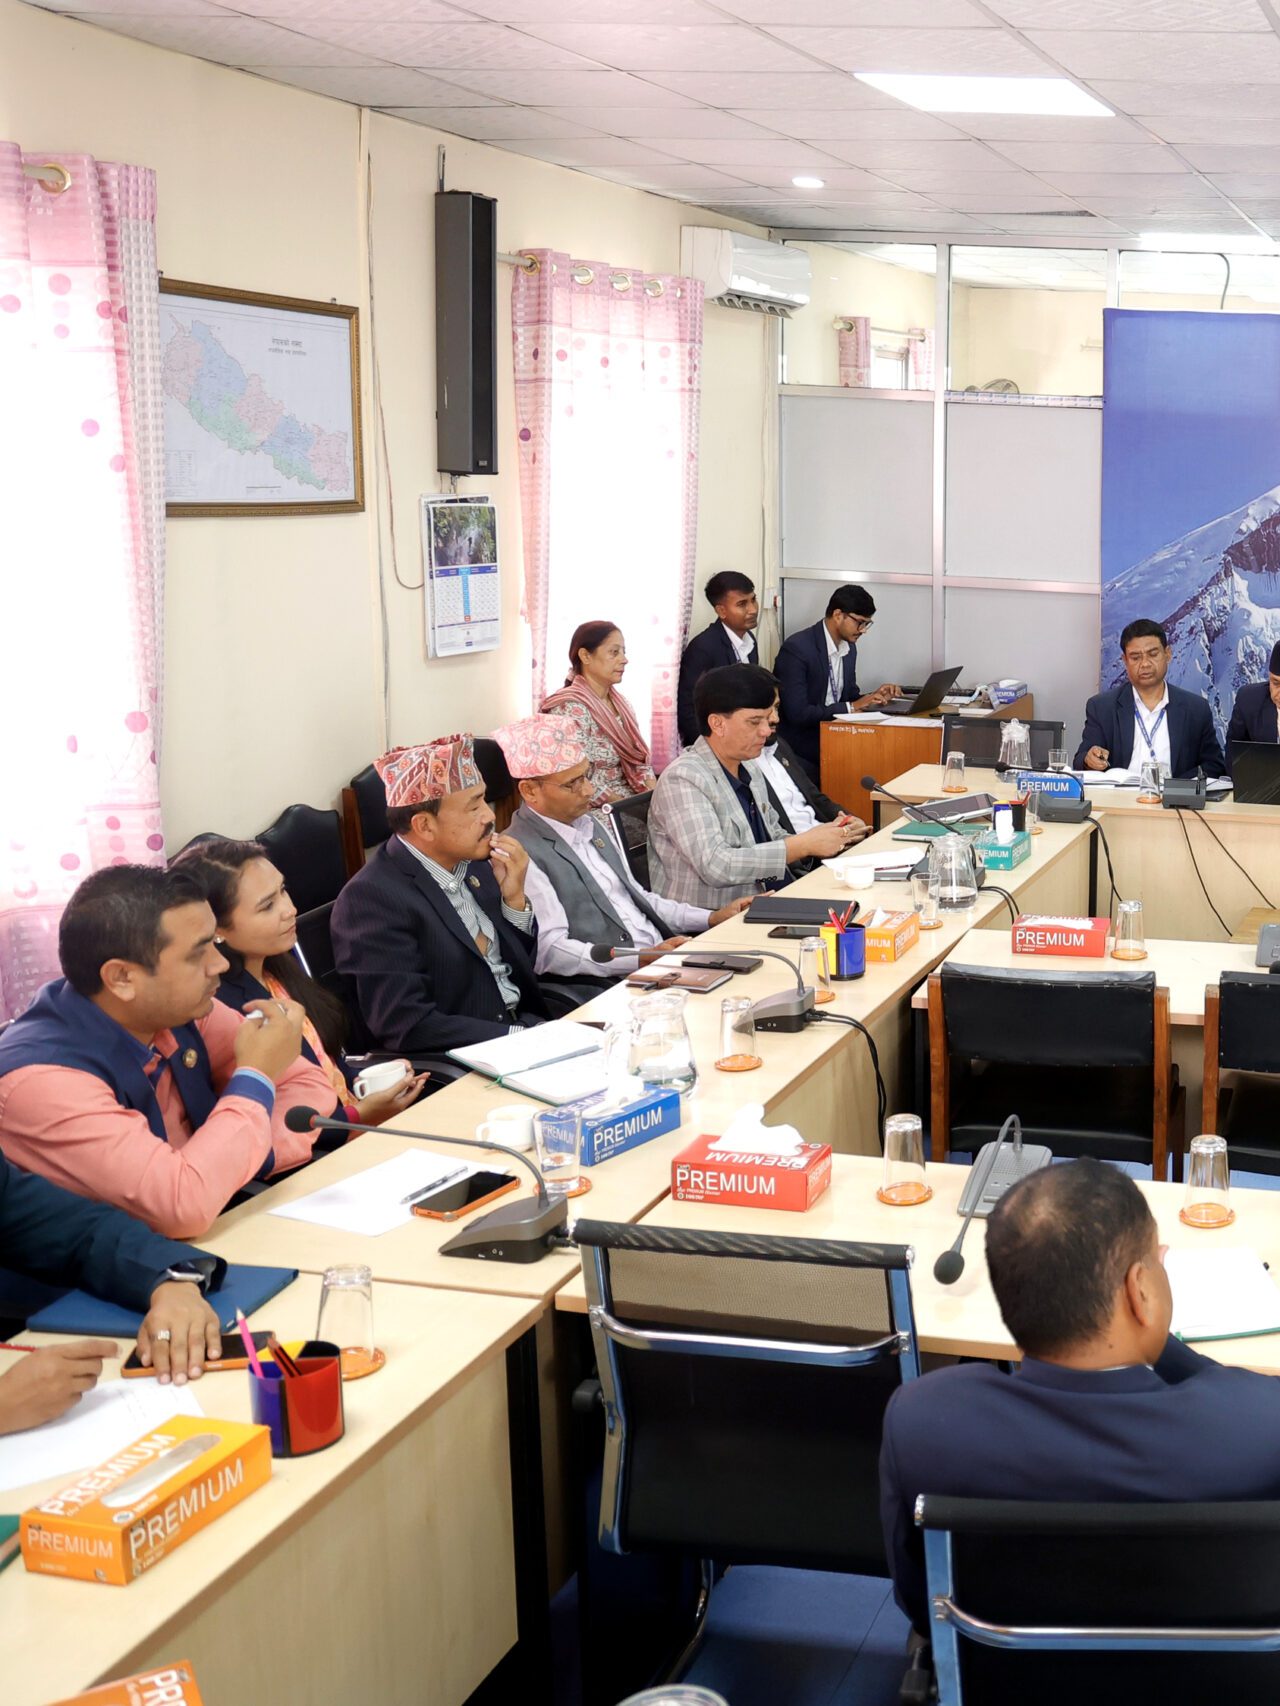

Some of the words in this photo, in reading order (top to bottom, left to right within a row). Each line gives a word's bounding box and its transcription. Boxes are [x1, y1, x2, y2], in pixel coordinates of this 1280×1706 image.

[1020, 781, 1069, 792] PREMIUM
[866, 938, 891, 948] MIUM
[1016, 931, 1084, 946] PREMIUM
[594, 1106, 662, 1151] PREMIUM
[705, 1152, 810, 1169] PREMIUM
[676, 1168, 775, 1195] PREMIUM
[40, 1434, 176, 1515] PREMIUM
[129, 1459, 244, 1560] PREMIUM
[27, 1528, 113, 1559] PREMIUM
